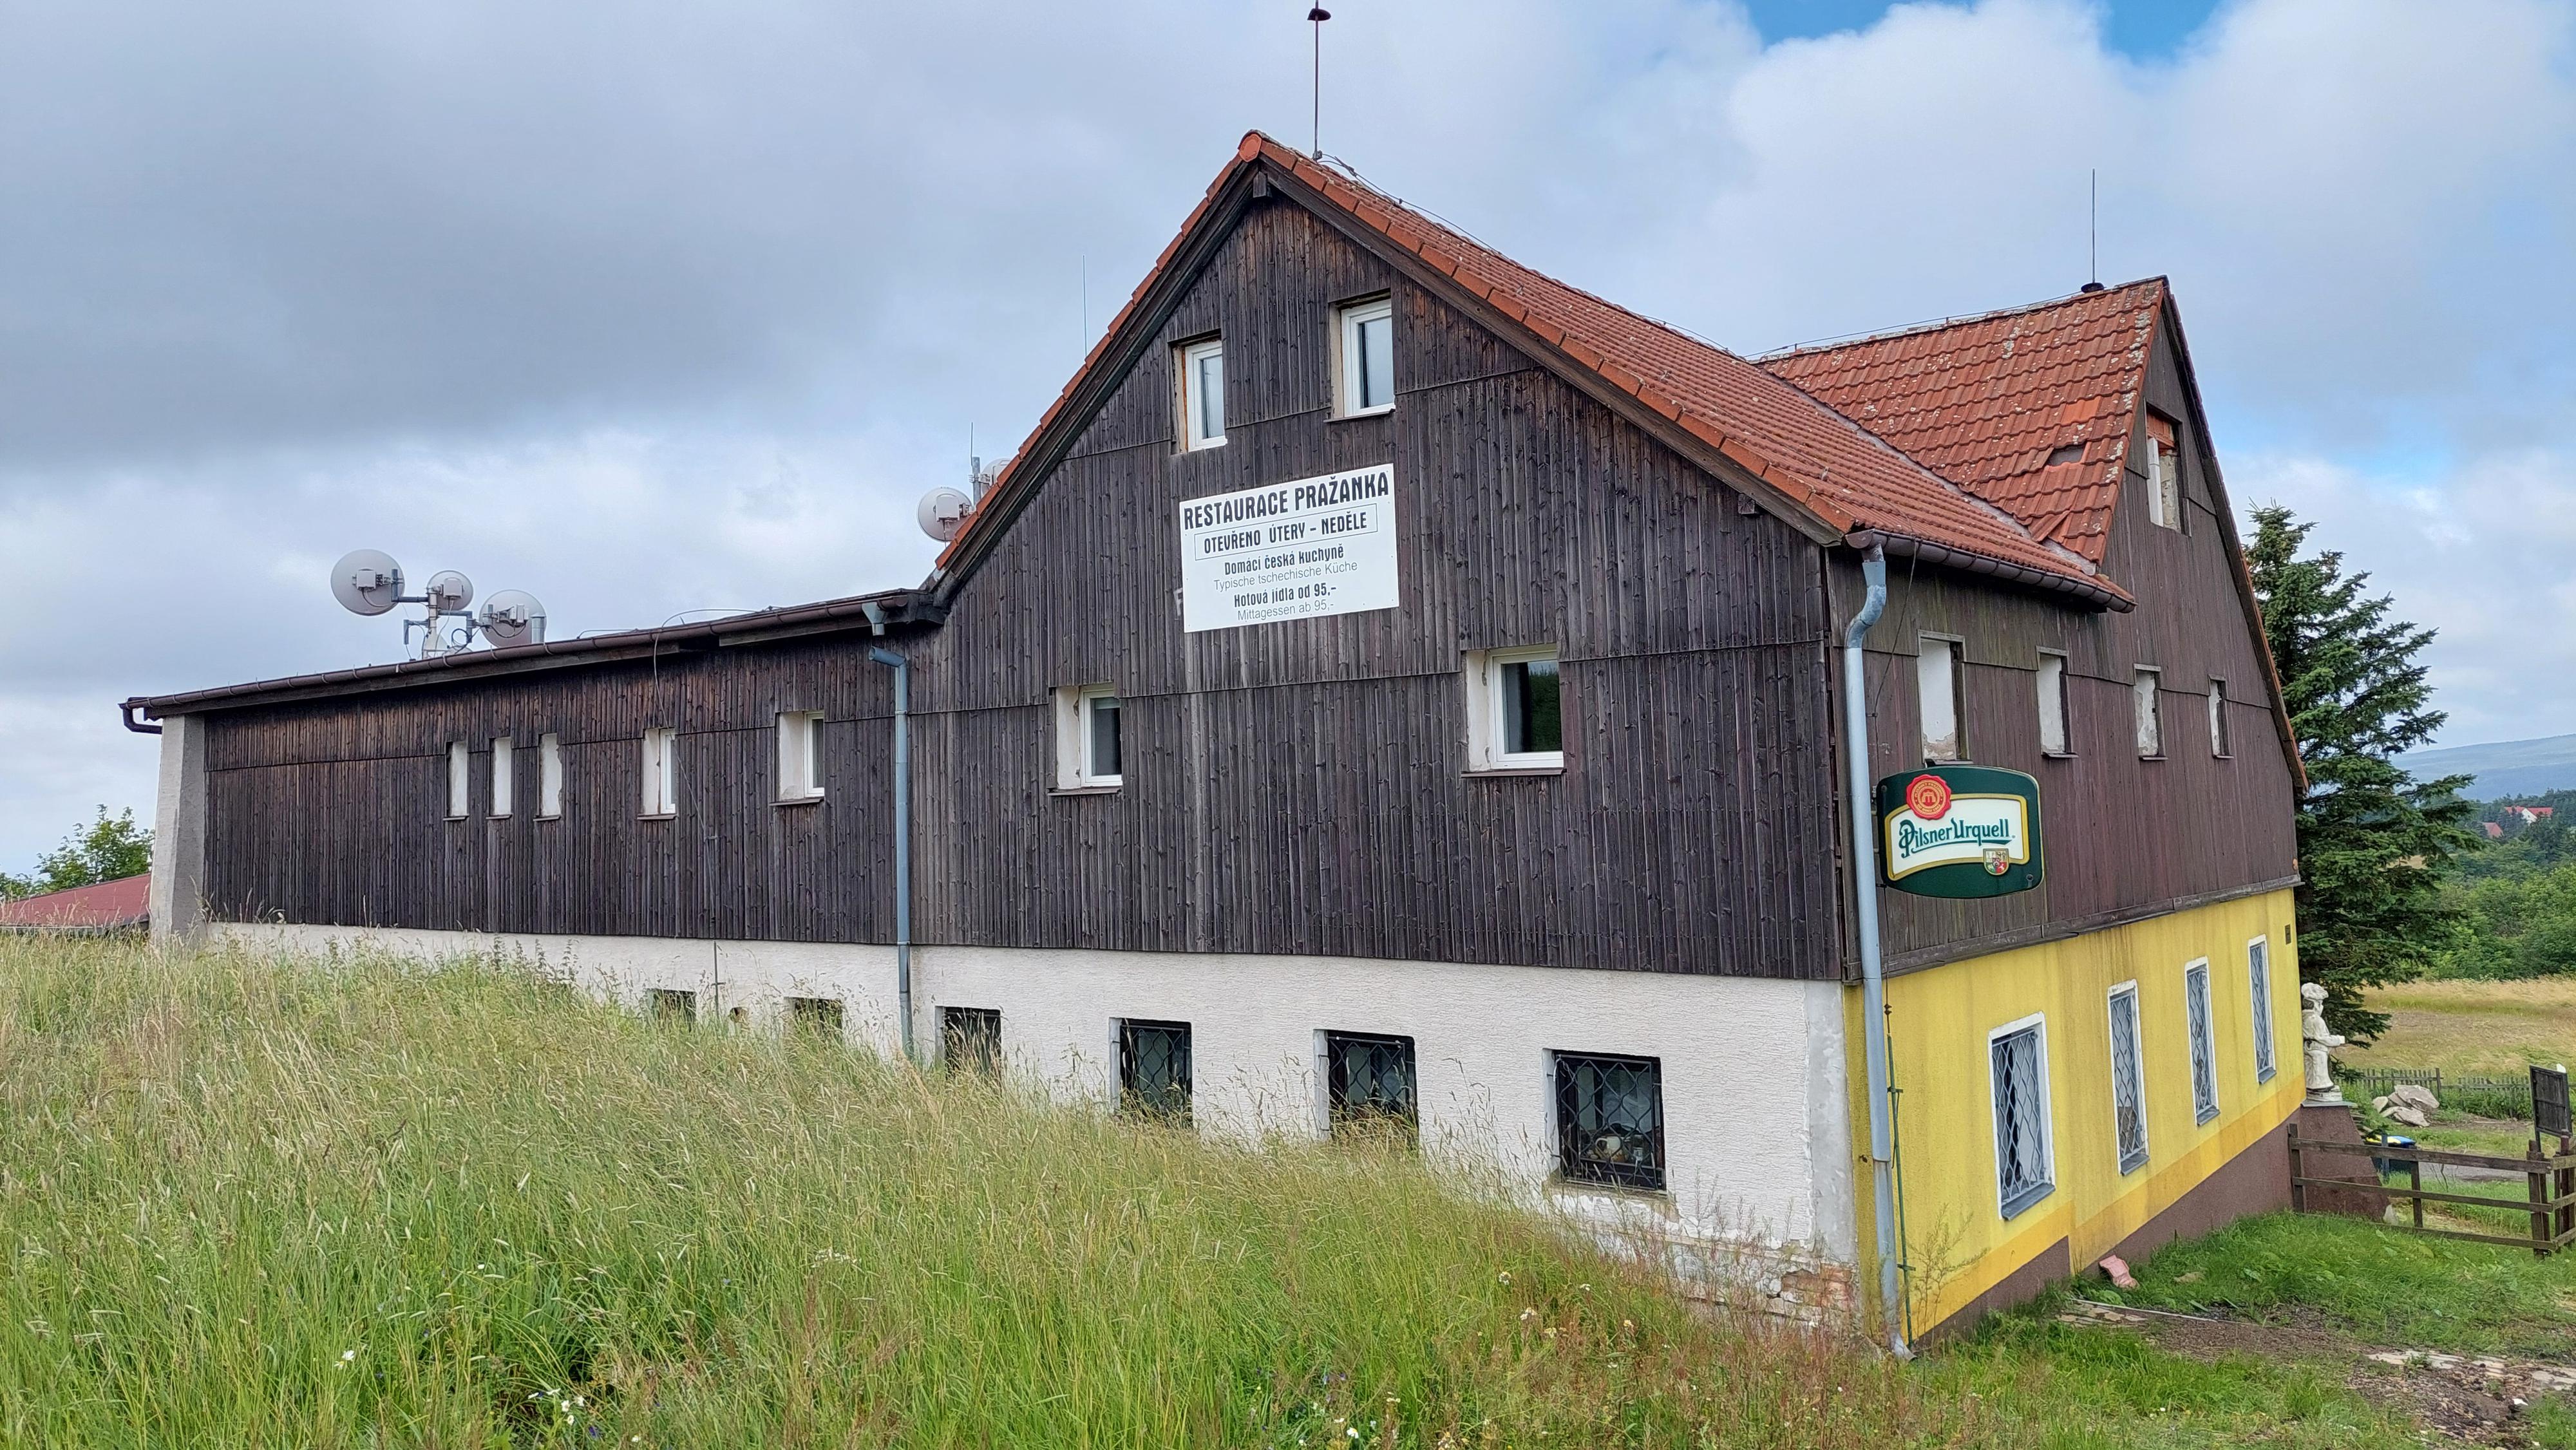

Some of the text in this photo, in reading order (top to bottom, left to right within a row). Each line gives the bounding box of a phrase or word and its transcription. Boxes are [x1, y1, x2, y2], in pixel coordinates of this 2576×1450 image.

[1184, 472, 1388, 530] RESTAURACE PRAŽANKA
[1204, 529, 1260, 554] OTEVŘENO
[1269, 522, 1305, 543] ÚTERY
[1321, 511, 1367, 535] NEDĚLE
[1225, 543, 1344, 575] Domácí česká kuchyně
[1214, 561, 1358, 592] Typische tschechische Küche
[1235, 589, 1268, 608] Hotová
[1272, 587, 1294, 604] jídla
[1298, 584, 1310, 599] od
[1238, 605, 1296, 621] Mittagessen
[1299, 601, 1311, 613] ab
[1899, 817, 2009, 858] Pilsner Urquell
